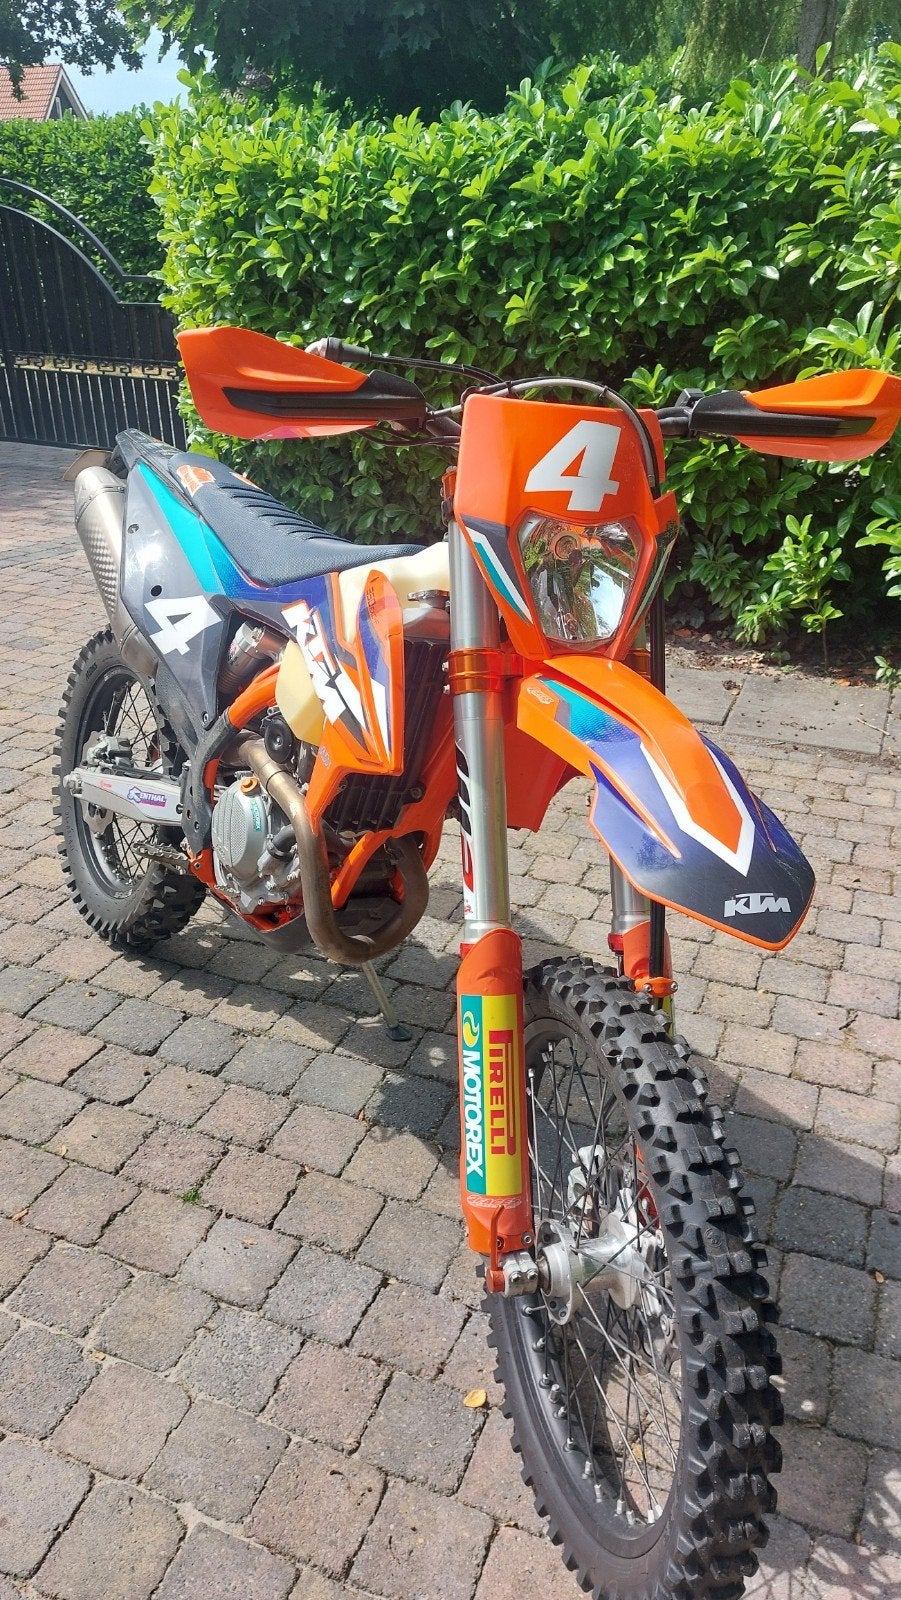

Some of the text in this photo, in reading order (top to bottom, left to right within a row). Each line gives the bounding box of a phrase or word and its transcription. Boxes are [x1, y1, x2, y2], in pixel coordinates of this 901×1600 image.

[524, 420, 621, 512] 4
[144, 595, 222, 656] 4
[281, 599, 346, 725] KTM
[723, 892, 792, 918] KTM
[463, 1049, 484, 1178] MOTOREX
[488, 1029, 515, 1156] PIRELLI
